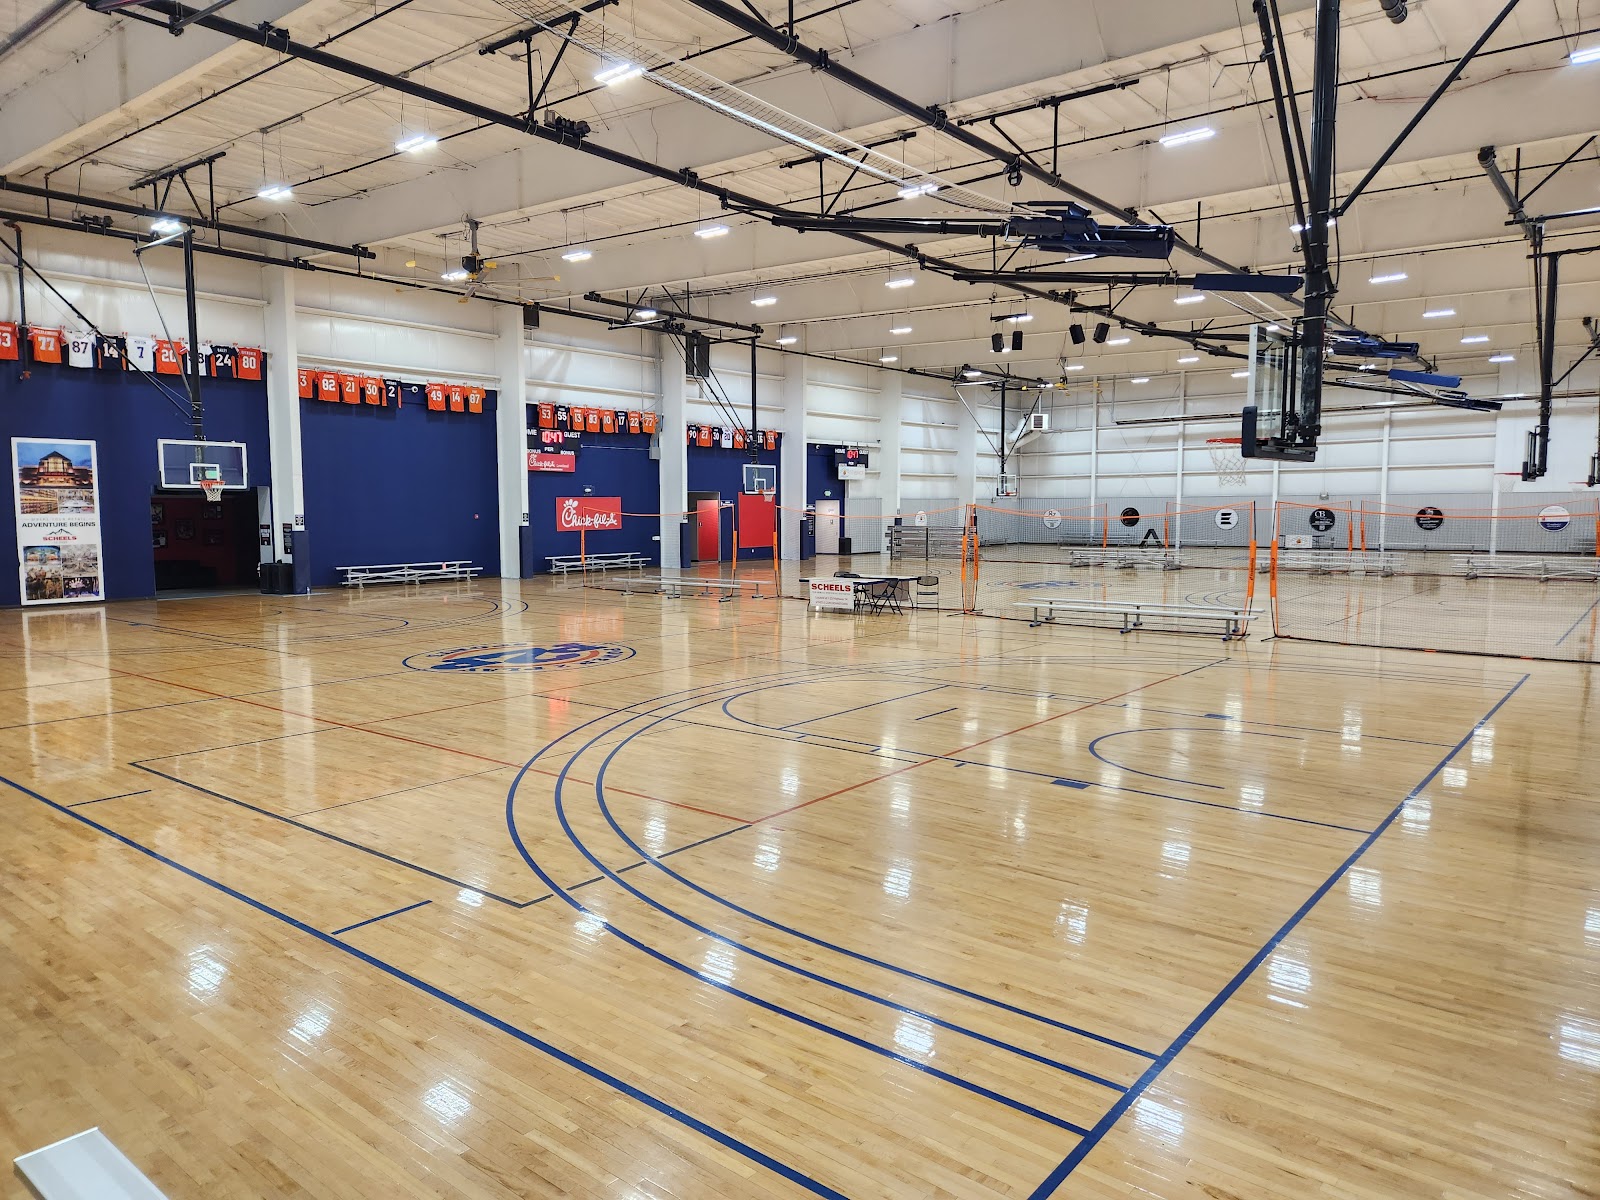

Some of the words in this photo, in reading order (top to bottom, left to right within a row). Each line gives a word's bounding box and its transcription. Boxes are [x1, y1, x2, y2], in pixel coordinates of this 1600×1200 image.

[0, 332, 11, 347] 3
[38, 336, 55, 351] 77
[72, 340, 88, 354] 87
[103, 342, 119, 358] 14
[136, 346, 144, 359] 7
[216, 353, 232, 367] 24
[242, 356, 256, 369] 80
[322, 379, 336, 391] 82
[345, 381, 355, 393] 21
[366, 383, 378, 395] 30
[388, 386, 396, 397] 2
[430, 390, 442, 401] 49
[452, 391, 460, 403] 14
[469, 393, 480, 404] 87
[541, 409, 551, 419] 53
[557, 411, 567, 421] 55
[618, 416, 625, 426] 17
[630, 417, 639, 427] 22
[564, 431, 581, 439] GUEST
[561, 503, 618, 528] Chick-fil-A
[811, 583, 851, 592] SCHEELS
